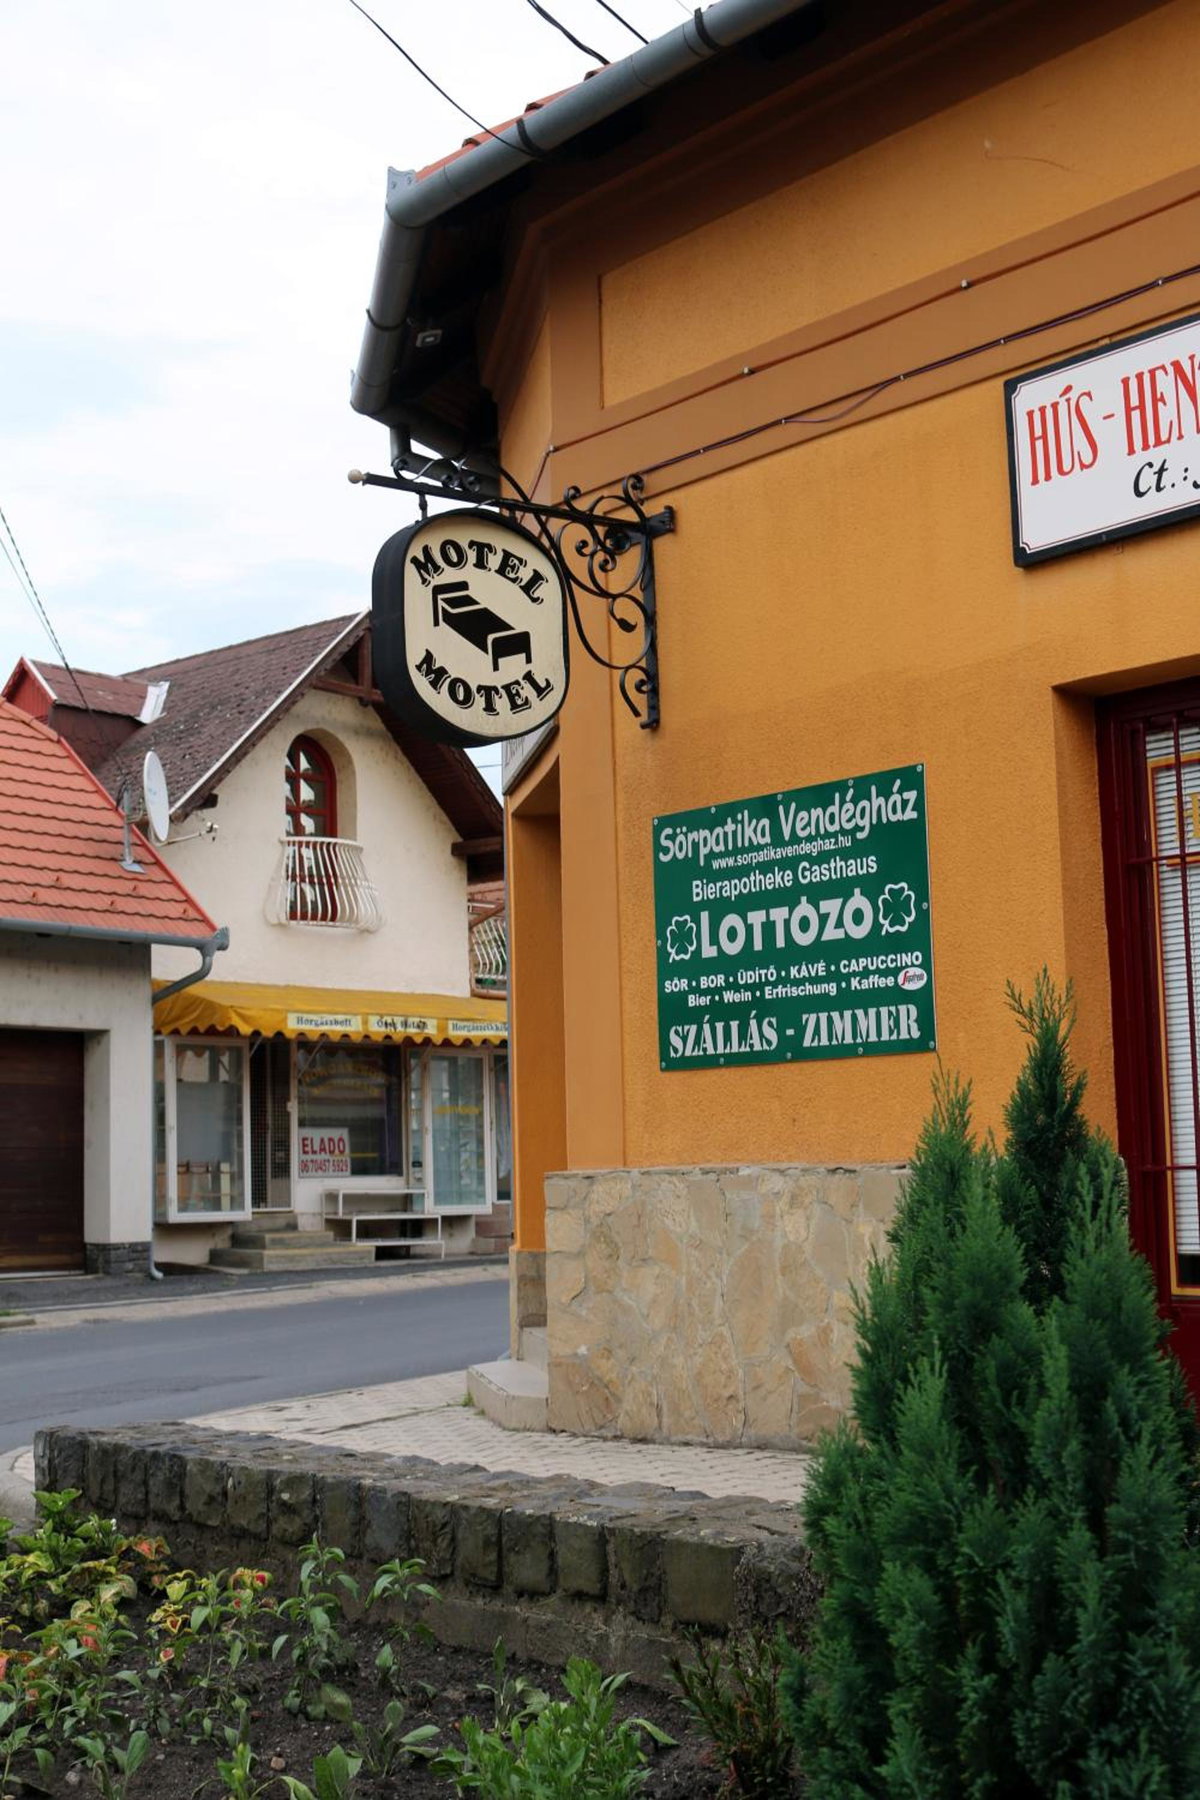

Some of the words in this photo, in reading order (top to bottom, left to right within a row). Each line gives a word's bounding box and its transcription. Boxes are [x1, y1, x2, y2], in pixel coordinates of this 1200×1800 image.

[1026, 353, 1200, 487] HÚS-HEN
[410, 539, 549, 605] MOTEL
[415, 648, 554, 715] MOTEL
[659, 809, 771, 867] Sörpatika
[778, 778, 918, 840] Vendégház
[692, 866, 793, 902] Bierapotheke
[798, 856, 877, 884] Gasthaus
[711, 833, 852, 870] www.sorpatikavendeghaz.hu
[664, 977, 689, 993] SÖR
[700, 974, 726, 989] BOR
[790, 960, 826, 979] KÁVÉ
[840, 951, 922, 973] CAPUCCINO
[688, 993, 712, 1007] Bier
[723, 989, 752, 1004] Wein
[764, 981, 837, 999] Erfrischung
[851, 974, 895, 990] Kaffee
[669, 1010, 778, 1058] SZÁLLÁS
[802, 1003, 921, 1048] ZIMMER
